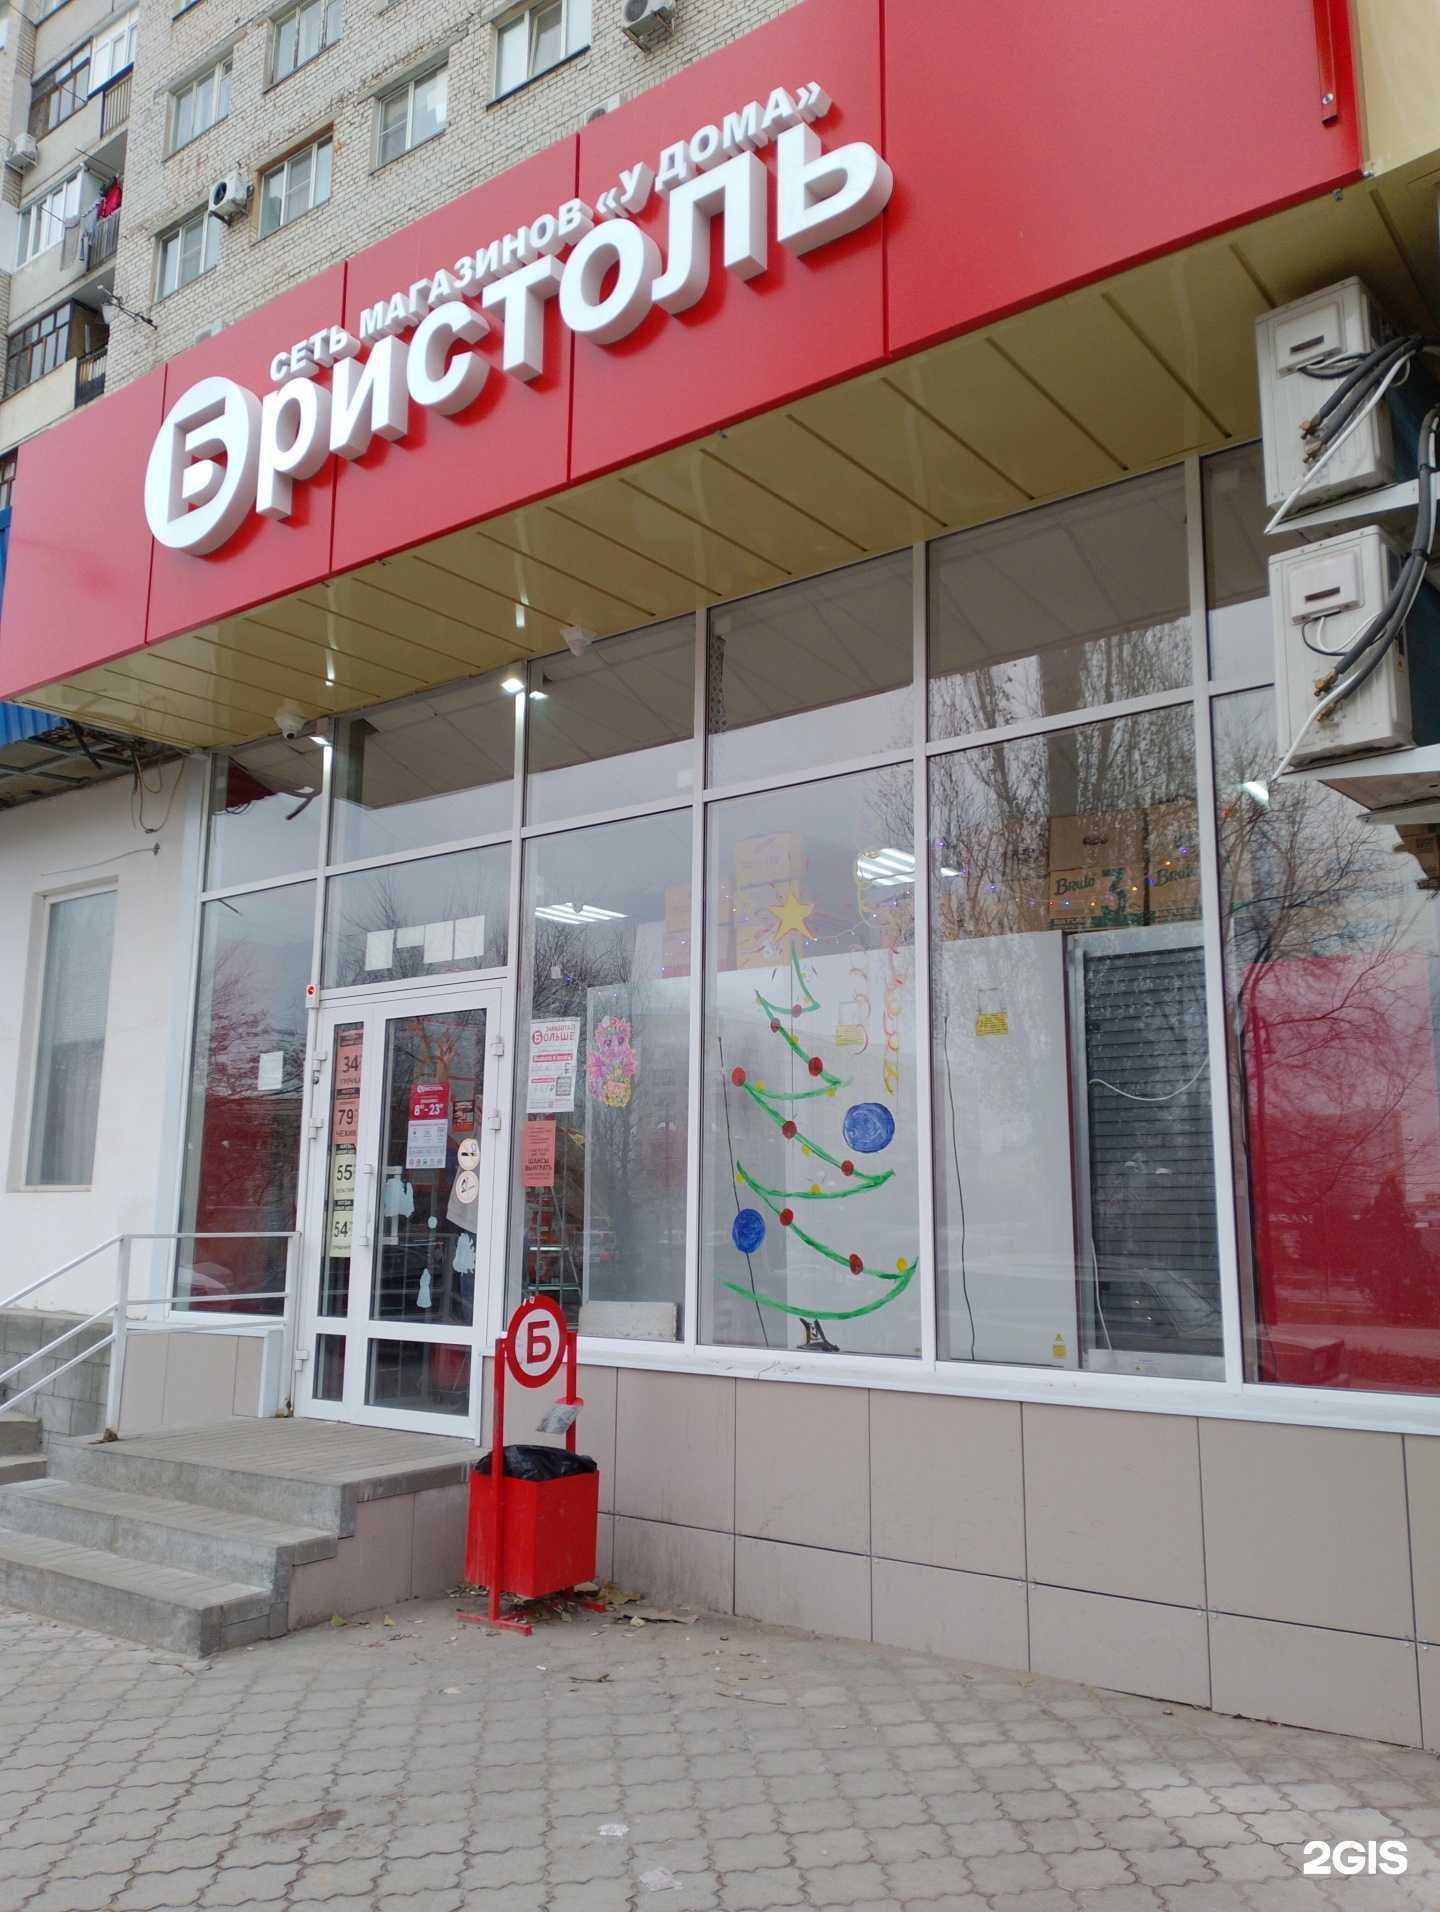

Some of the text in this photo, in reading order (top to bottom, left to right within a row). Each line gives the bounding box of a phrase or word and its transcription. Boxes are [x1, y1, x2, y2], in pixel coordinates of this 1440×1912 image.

[270, 81, 828, 382] СЕТЬ МАГАЗИНОВ «У ДОМА»
[532, 1030, 576, 1045] БОЛЬШЕ
[336, 1164, 353, 1181] 55
[526, 1320, 553, 1364] Б
